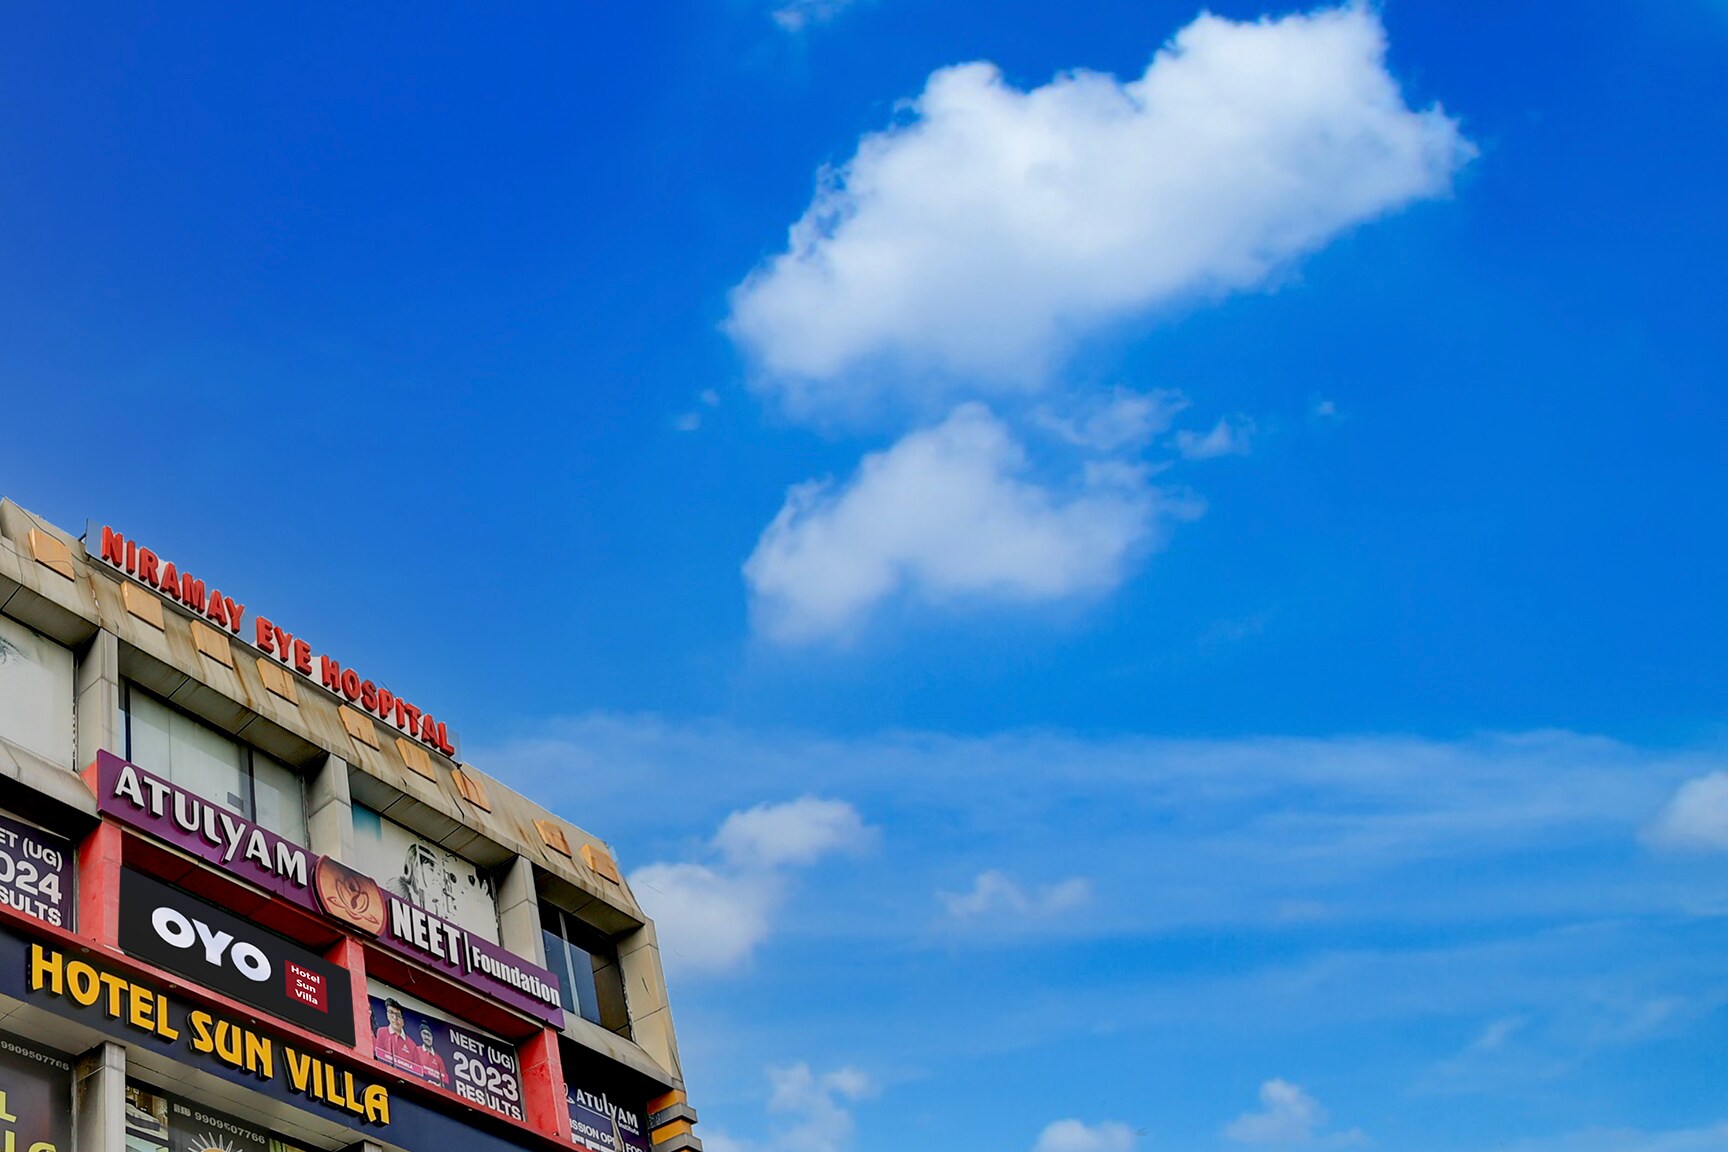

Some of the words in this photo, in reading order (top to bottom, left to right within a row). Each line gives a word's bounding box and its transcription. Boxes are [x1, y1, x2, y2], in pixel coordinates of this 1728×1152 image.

[101, 525, 246, 635] NIRAMAY
[256, 615, 313, 677] EYE
[320, 654, 456, 757] HOSPITAL
[114, 765, 308, 888] ATULYAM
[22, 837, 63, 873] (UG)
[151, 906, 272, 982] OYO
[390, 896, 461, 966] NEET
[472, 944, 562, 1008] Foundation
[291, 964, 320, 985] Hotel
[296, 979, 316, 994] Sun
[294, 988, 318, 1006] Villa
[31, 943, 179, 1041] HOTEL
[191, 1010, 274, 1080] SUN
[285, 1046, 390, 1126] VILLA
[449, 1029, 485, 1057] NEET
[487, 1046, 515, 1073] (UG)
[453, 1052, 519, 1102] 2023
[455, 1079, 523, 1122] RESULTS
[576, 1088, 639, 1129] ATULYAM
[194, 1111, 267, 1145] 9909507766
